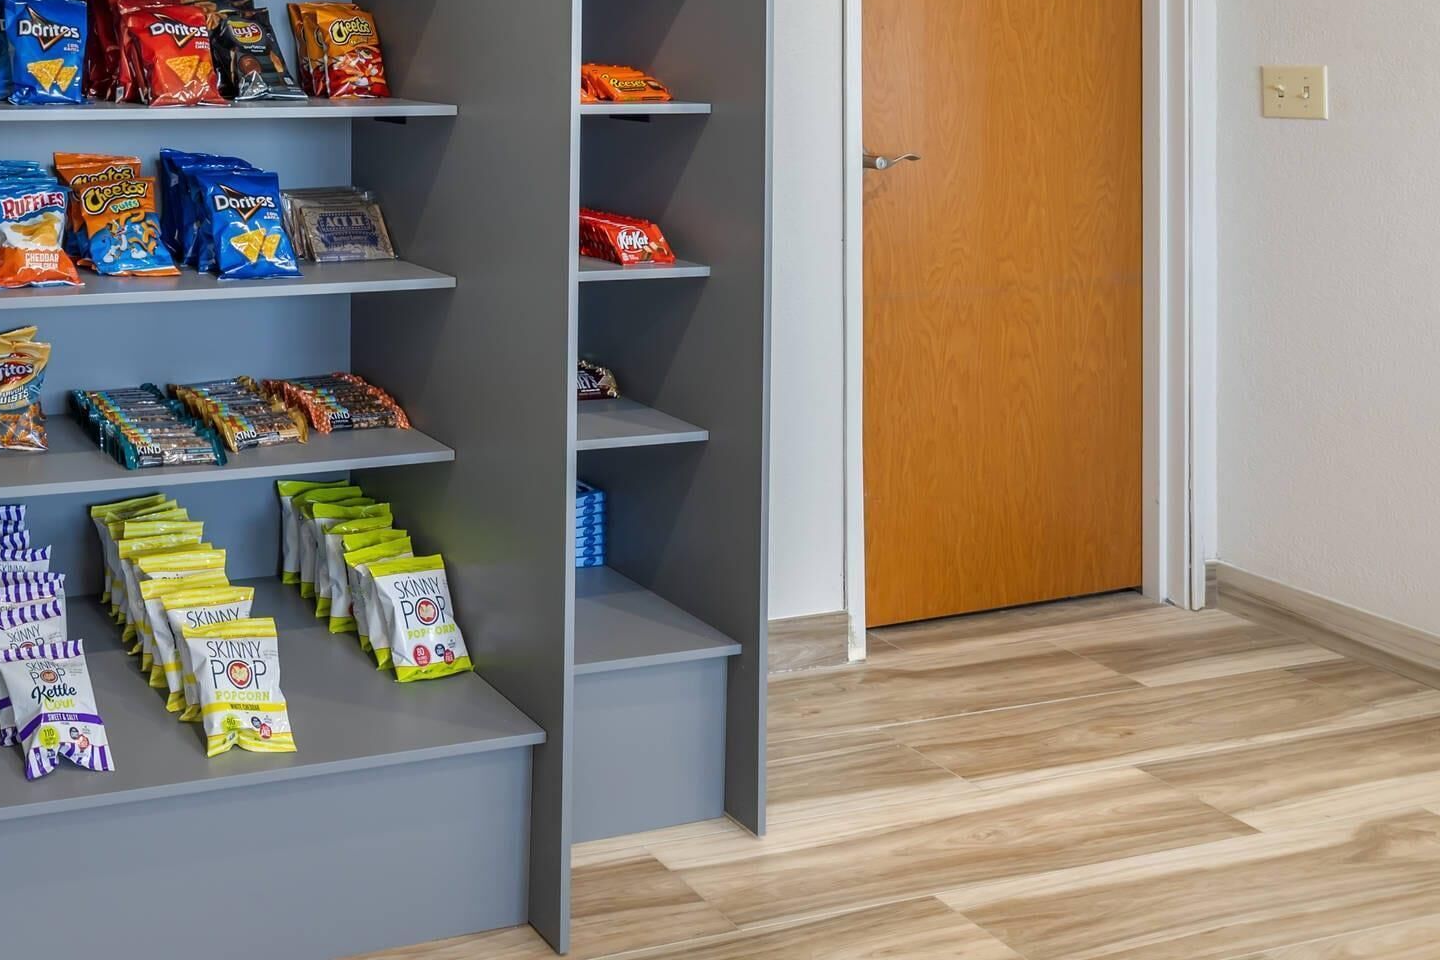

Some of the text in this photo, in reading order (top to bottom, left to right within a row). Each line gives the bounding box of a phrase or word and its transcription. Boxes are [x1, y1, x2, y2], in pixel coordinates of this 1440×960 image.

[19, 19, 80, 38] Doritos
[150, 23, 209, 37] Doritos
[331, 19, 372, 44] Cheetos
[3, 193, 65, 218] RUFFLES
[85, 182, 145, 211] Cheetos
[214, 195, 276, 210] Doritos
[325, 216, 348, 226] ACT
[329, 411, 350, 420] KIND
[234, 431, 257, 441] KIND
[136, 444, 161, 456] KIND
[394, 576, 440, 599] SKINNY
[186, 607, 239, 629] SKINNY
[401, 597, 446, 628] POP
[7, 624, 41, 642] SKINNY
[206, 640, 262, 658] SKINNY
[30, 668, 65, 685] POP
[210, 660, 267, 689] POP
[31, 683, 77, 704] Kettle
[215, 691, 270, 701] POPCORN
[45, 697, 76, 711] Corn
